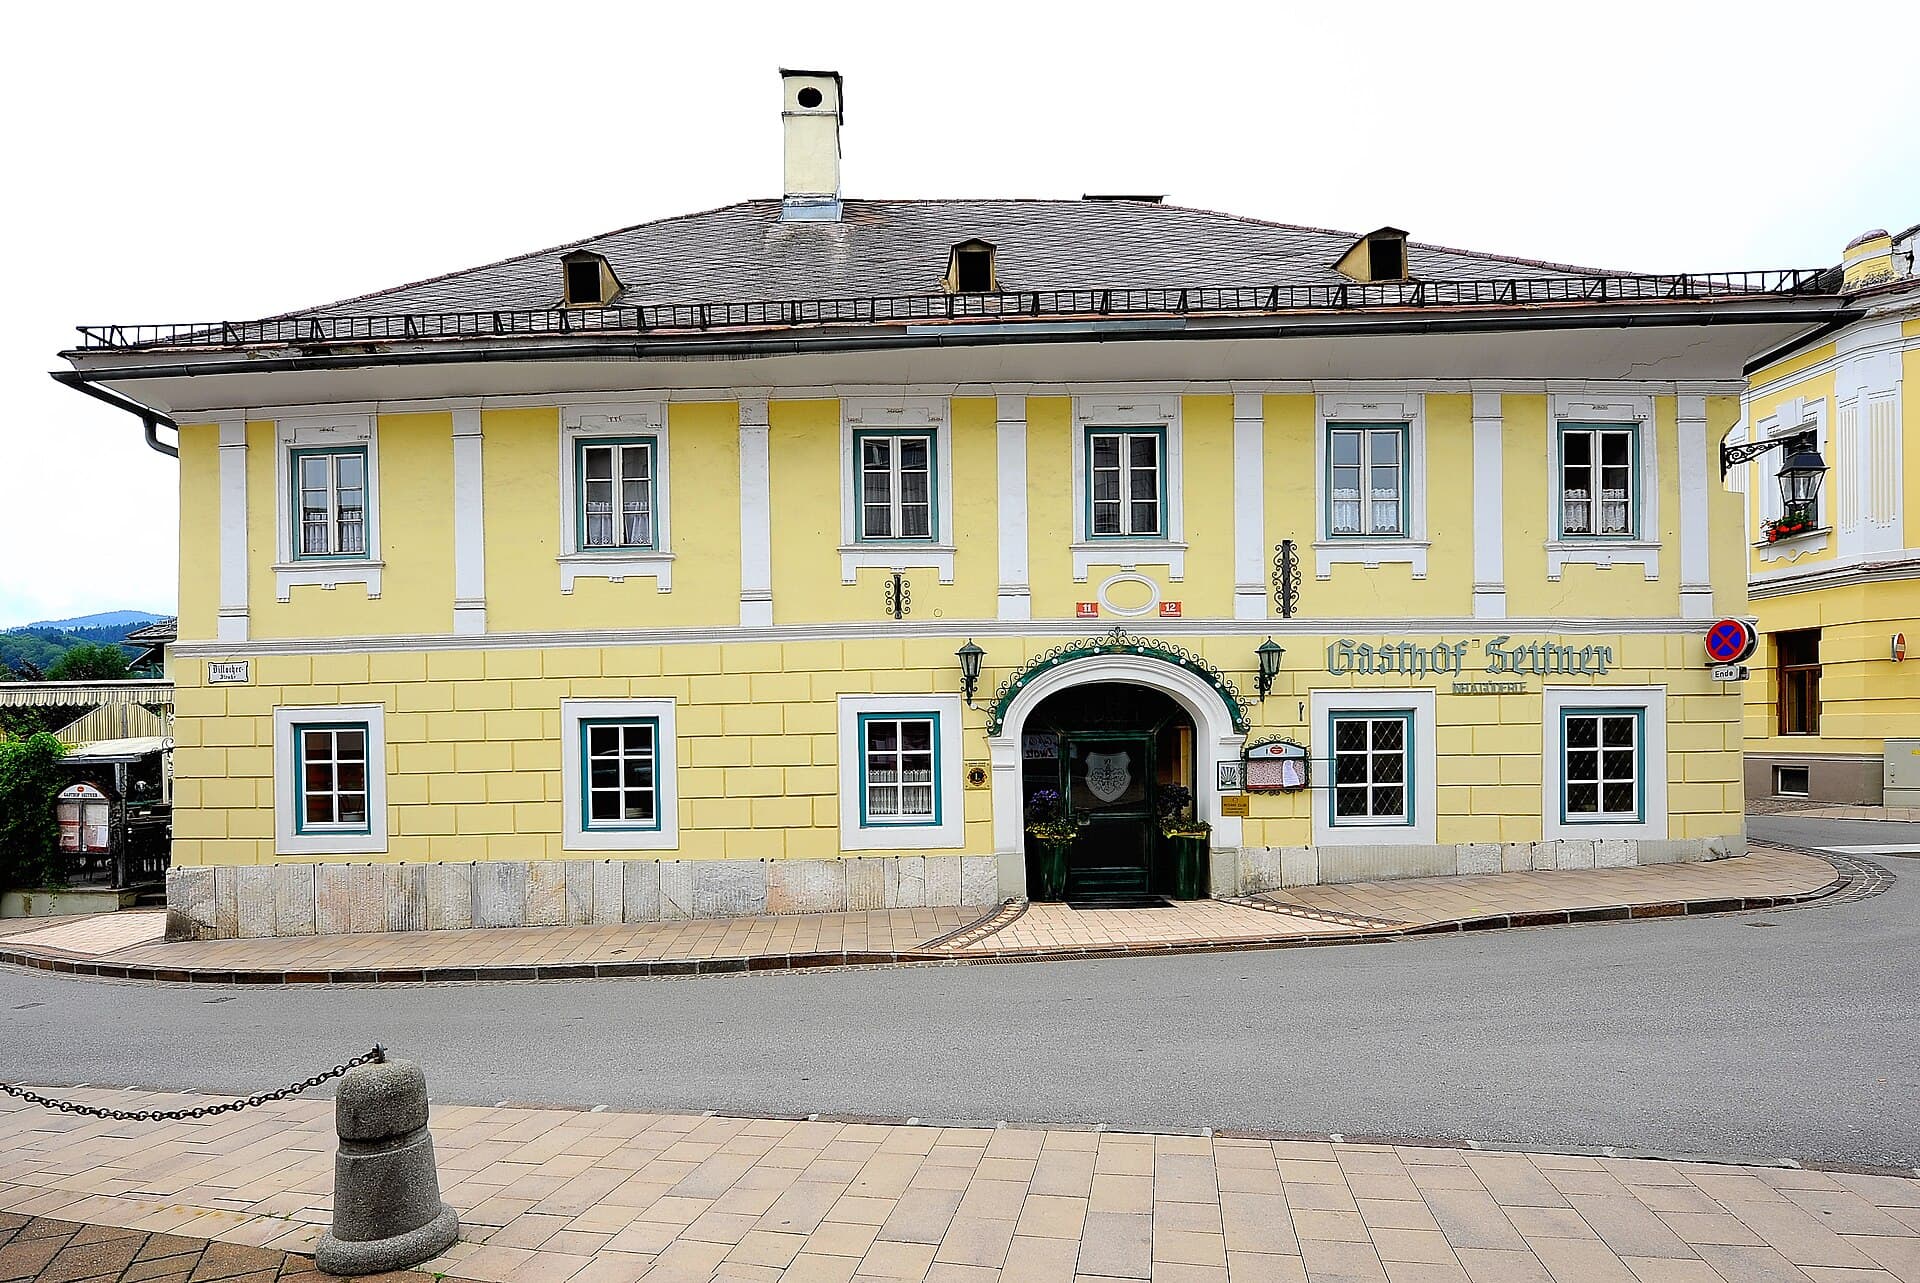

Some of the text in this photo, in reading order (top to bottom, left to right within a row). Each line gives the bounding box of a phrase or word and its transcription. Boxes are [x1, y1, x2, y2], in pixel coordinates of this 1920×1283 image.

[1083, 602, 1092, 613] 11
[1165, 602, 1177, 612] 12
[1327, 635, 1613, 681] Gasthof Seitner
[1714, 669, 1734, 678] Ende
